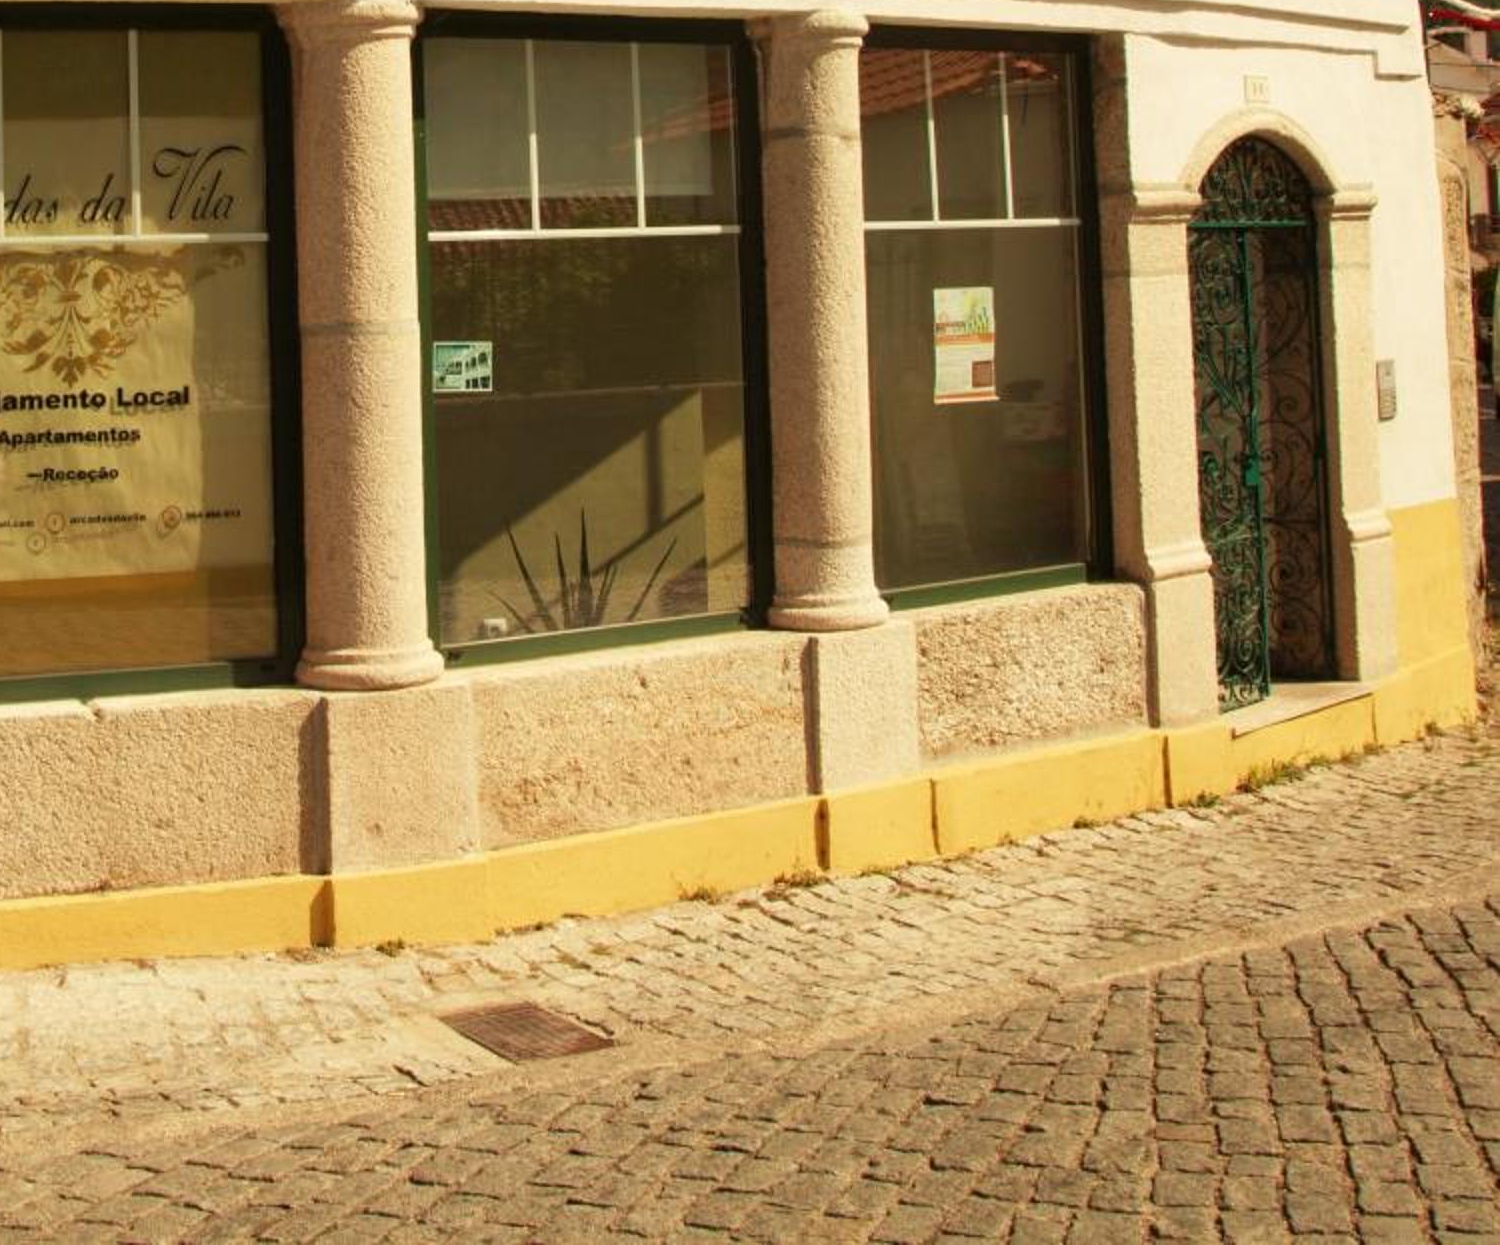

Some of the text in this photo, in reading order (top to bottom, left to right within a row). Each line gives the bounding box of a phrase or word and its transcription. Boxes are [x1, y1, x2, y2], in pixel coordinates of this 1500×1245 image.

[80, 172, 127, 225] da
[152, 144, 247, 223] Vila
[116, 386, 190, 407] Local
